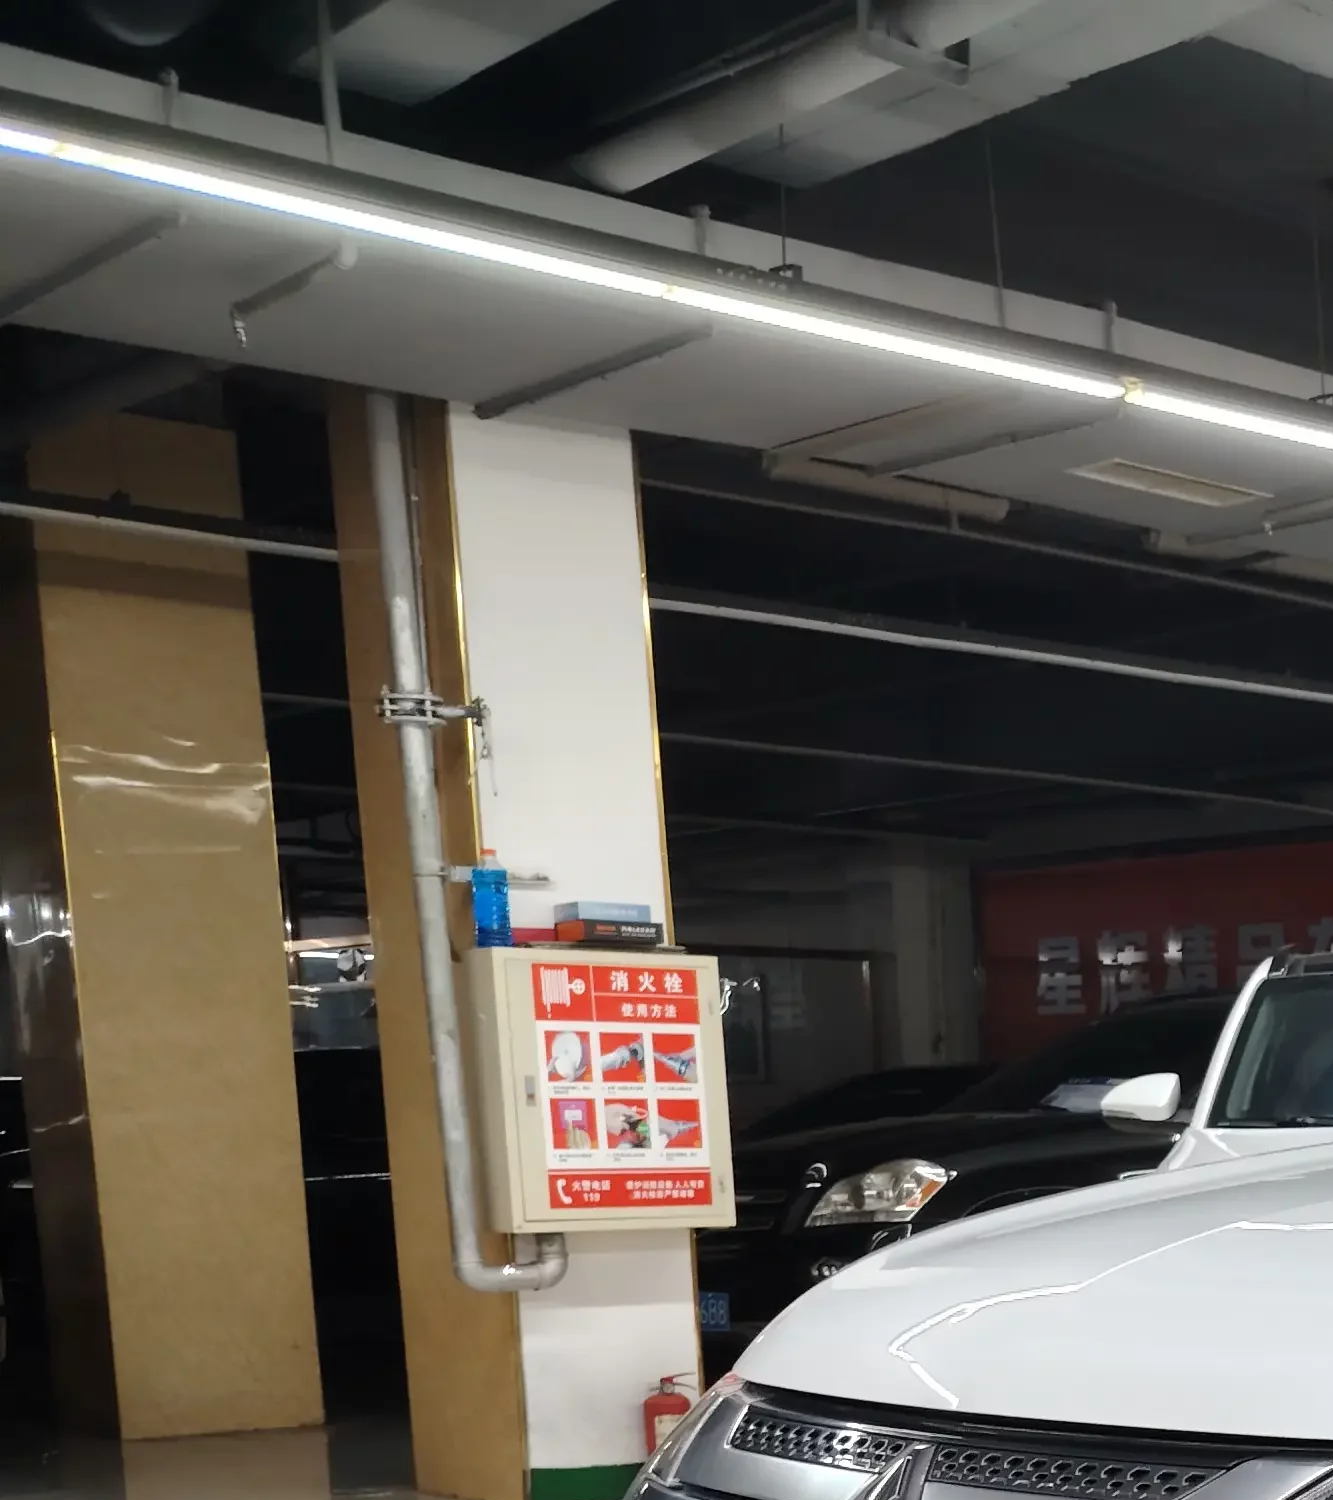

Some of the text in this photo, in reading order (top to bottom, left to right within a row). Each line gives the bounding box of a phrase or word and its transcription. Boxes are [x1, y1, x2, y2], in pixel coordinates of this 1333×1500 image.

[610, 970, 684, 993] 消火栓
[621, 1002, 678, 1019] 使用方法
